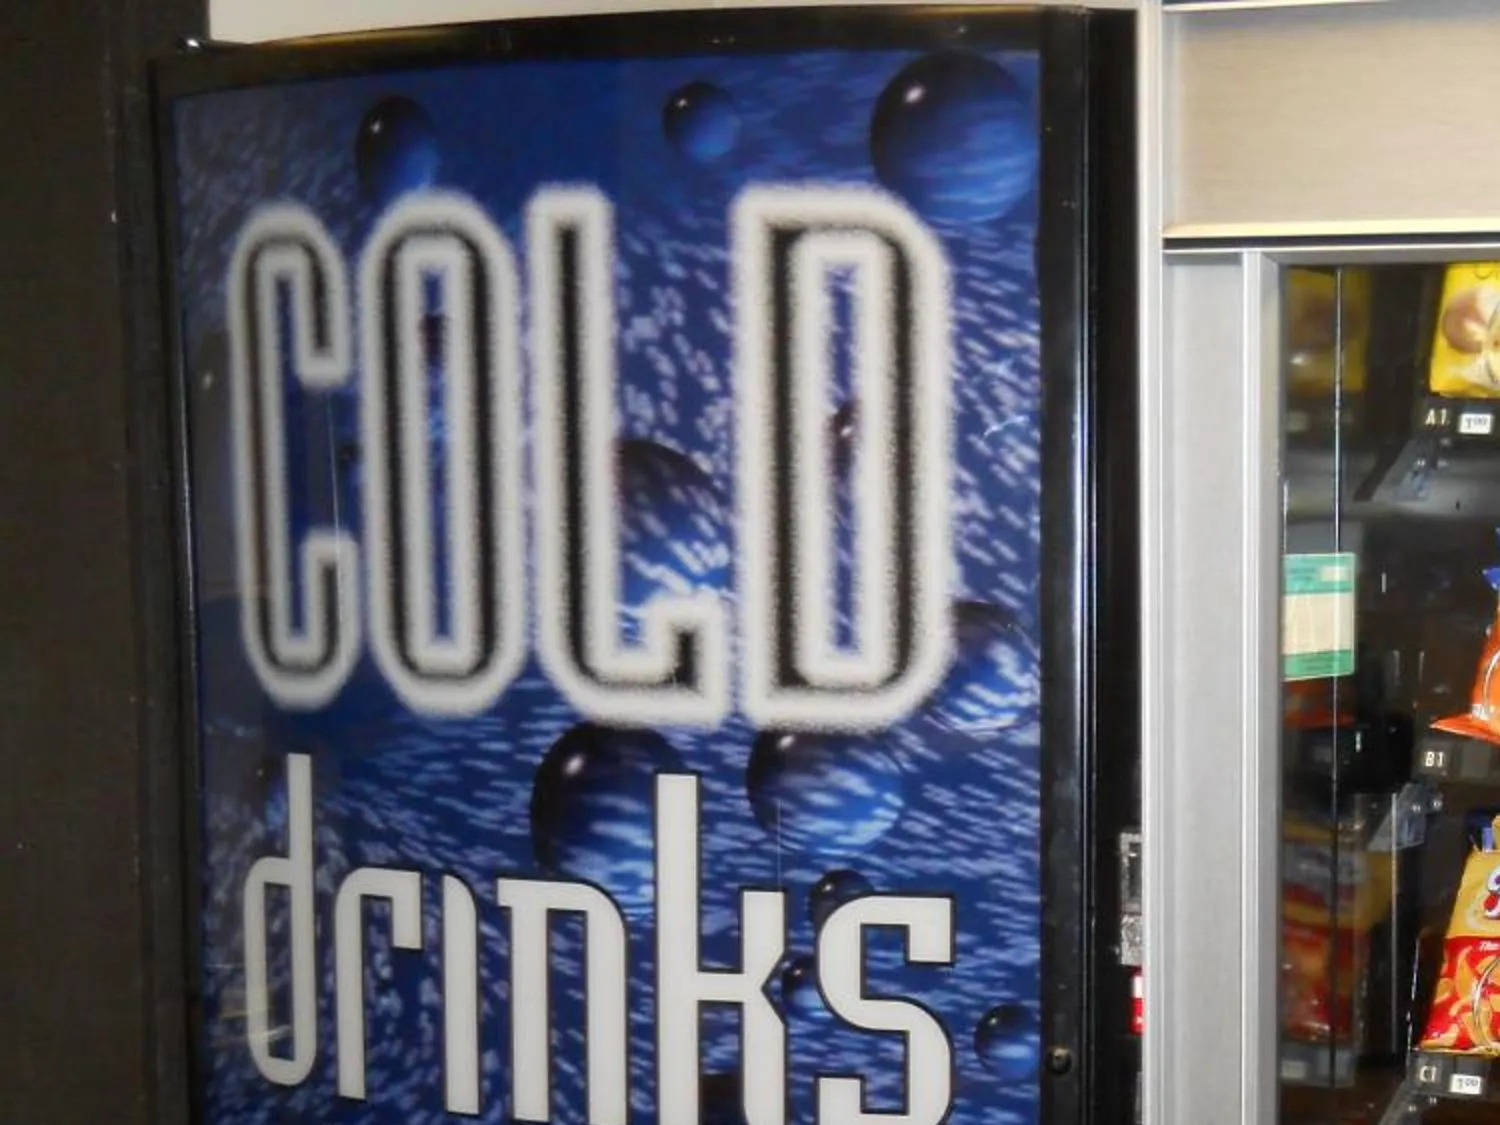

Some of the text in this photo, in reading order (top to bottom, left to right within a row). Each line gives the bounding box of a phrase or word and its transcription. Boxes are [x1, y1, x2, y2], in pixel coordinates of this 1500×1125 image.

[1425, 408, 1447, 426] A1
[227, 182, 953, 732] COLD
[1424, 751, 1445, 768] B1
[1418, 1065, 1438, 1083] C1
